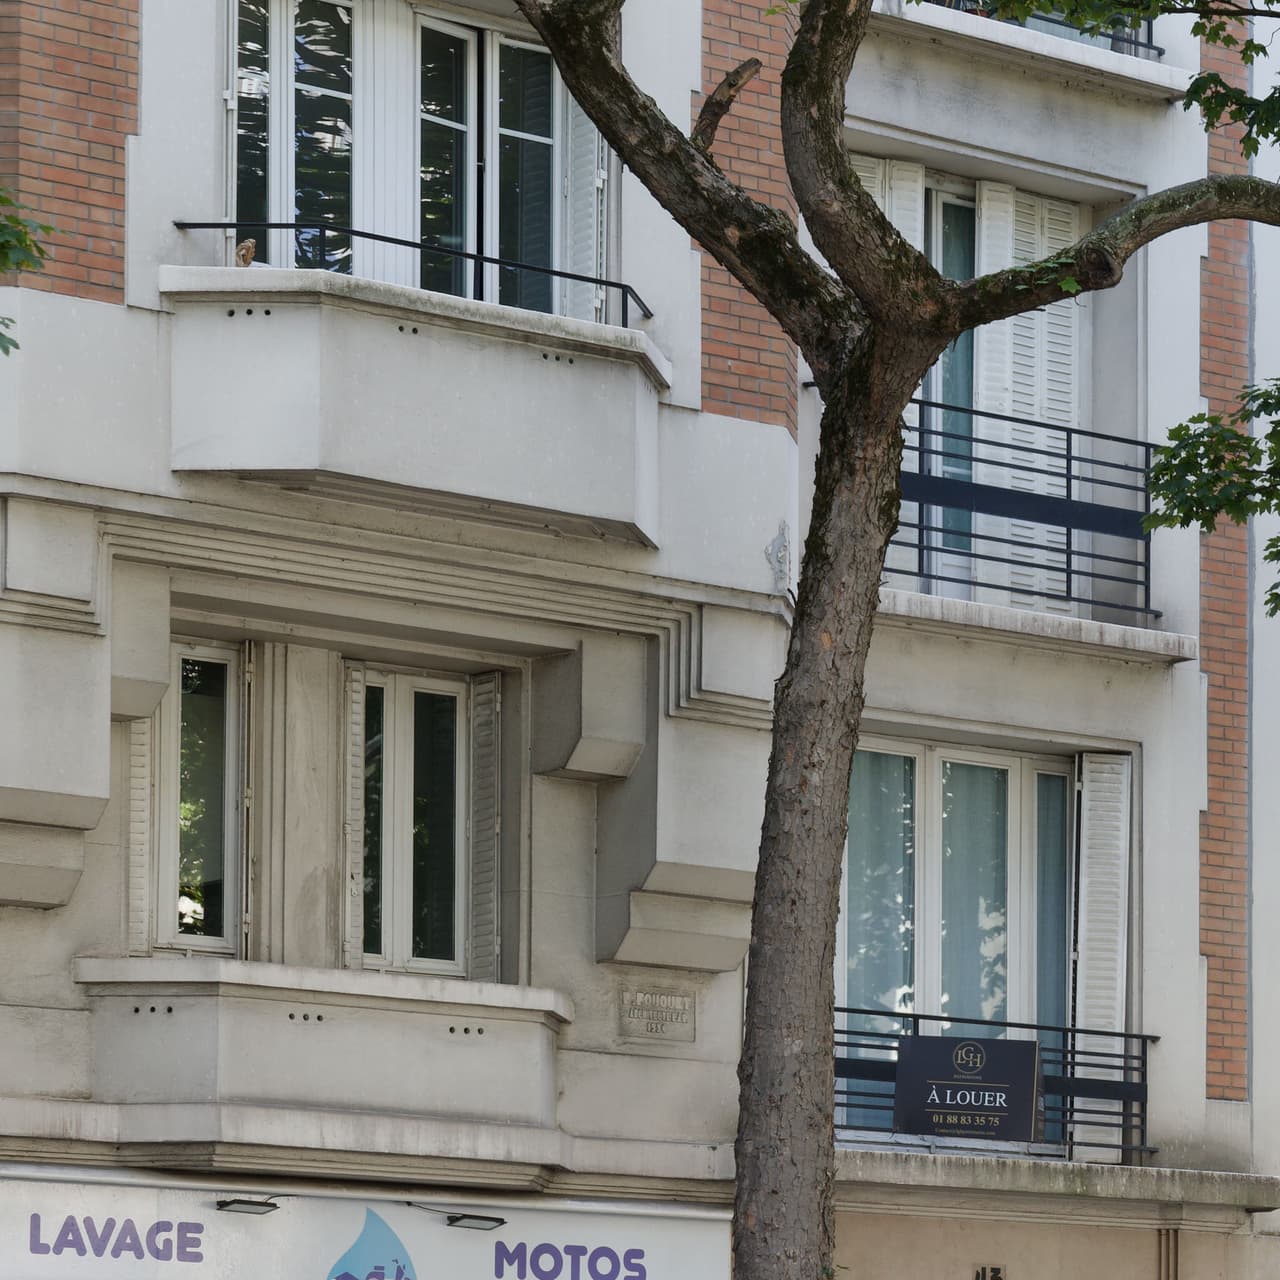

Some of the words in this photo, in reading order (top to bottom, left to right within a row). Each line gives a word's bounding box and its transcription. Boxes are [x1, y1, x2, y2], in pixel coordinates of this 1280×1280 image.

[927, 1085, 940, 1103] À
[945, 1090, 1008, 1107] LOUER
[932, 1114, 943, 1124] 01
[974, 1116, 985, 1126] 35
[988, 1117, 1000, 1126] 75
[29, 1212, 205, 1263] LAVAGE
